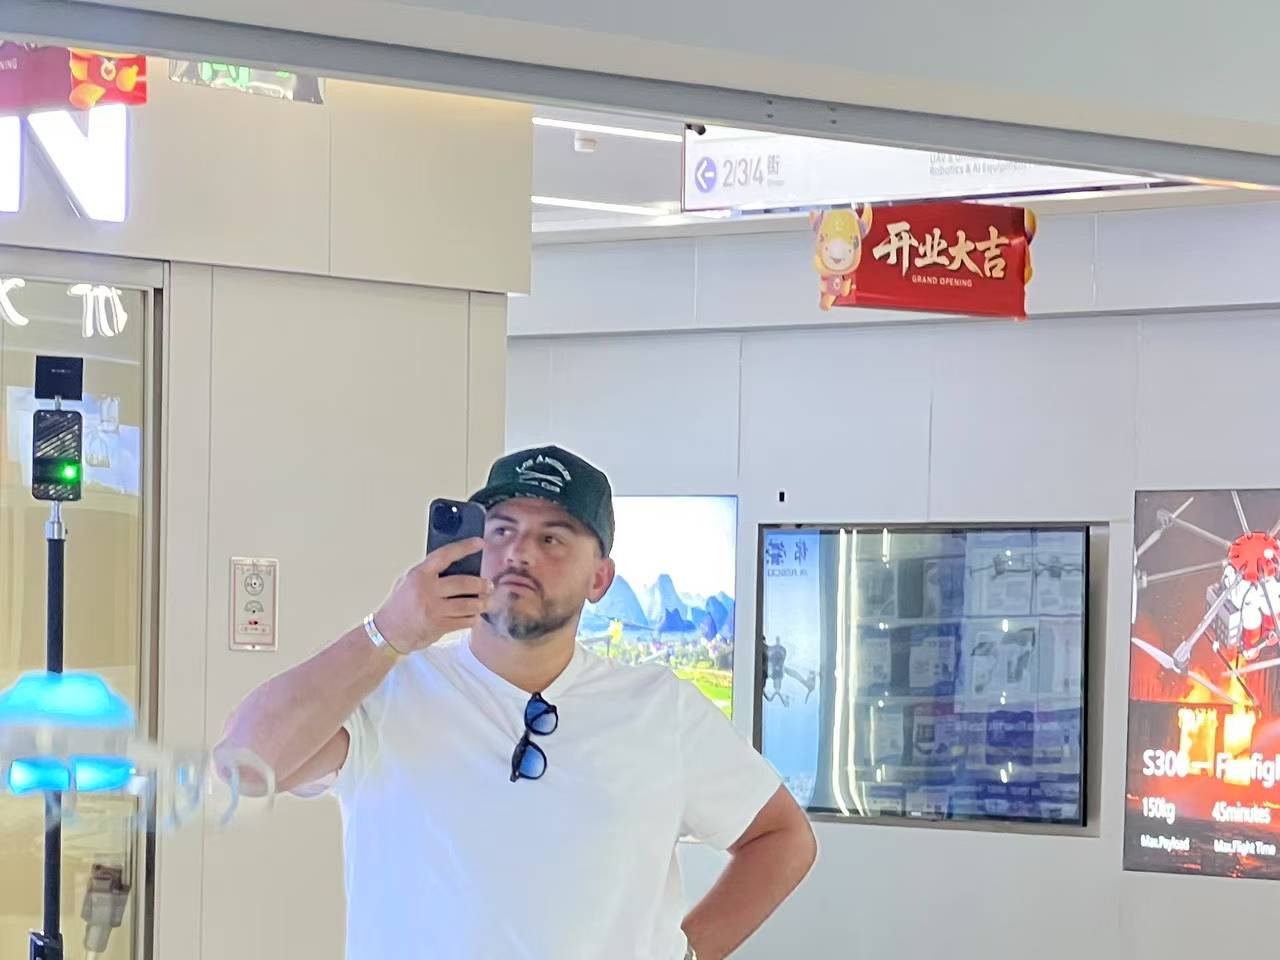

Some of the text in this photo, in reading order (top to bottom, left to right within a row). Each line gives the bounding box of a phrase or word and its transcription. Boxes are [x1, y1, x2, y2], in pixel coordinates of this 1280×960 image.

[722, 154, 781, 187] 2/3/4 街
[872, 221, 1010, 278] 开业大吉
[912, 273, 972, 288] GRAND OPENING
[1142, 796, 1176, 825] 150kg
[1212, 801, 1272, 825] 45minutes
